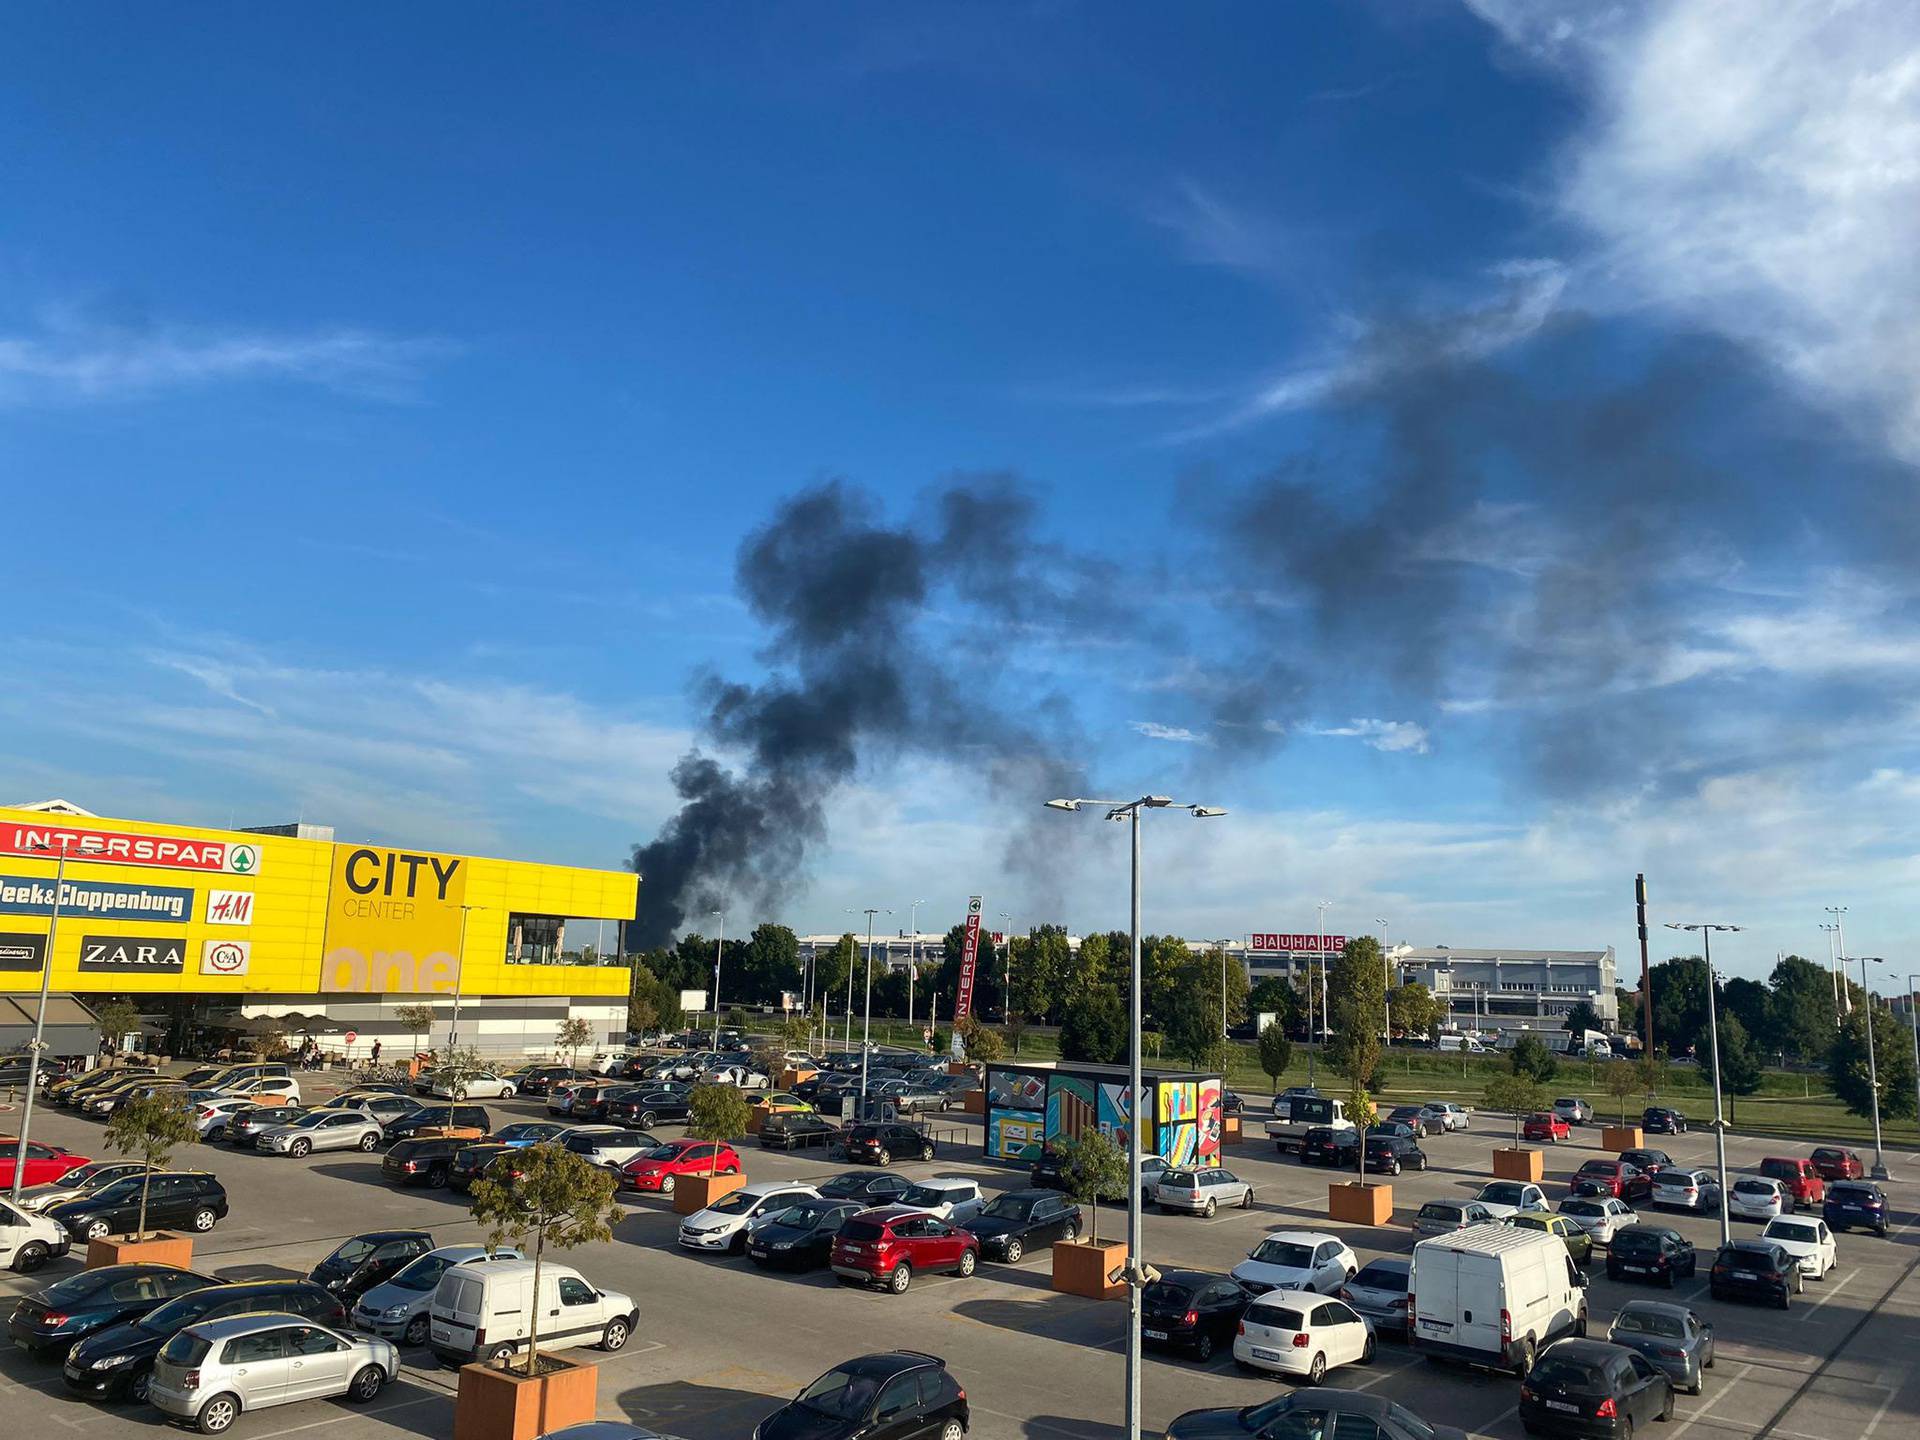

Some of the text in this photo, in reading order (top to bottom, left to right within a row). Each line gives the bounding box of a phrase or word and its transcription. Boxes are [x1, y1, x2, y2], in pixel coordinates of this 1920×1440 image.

[14, 829, 222, 865] INTERSPAR
[345, 849, 460, 900] CITY
[0, 879, 184, 916] eek&Cloppenburg
[212, 894, 251, 921] H&M
[343, 898, 415, 920] CENTER
[83, 944, 183, 965] ZARA
[1254, 935, 1344, 949] BAUHAUS
[216, 950, 238, 964] C&A
[323, 946, 458, 993] one
